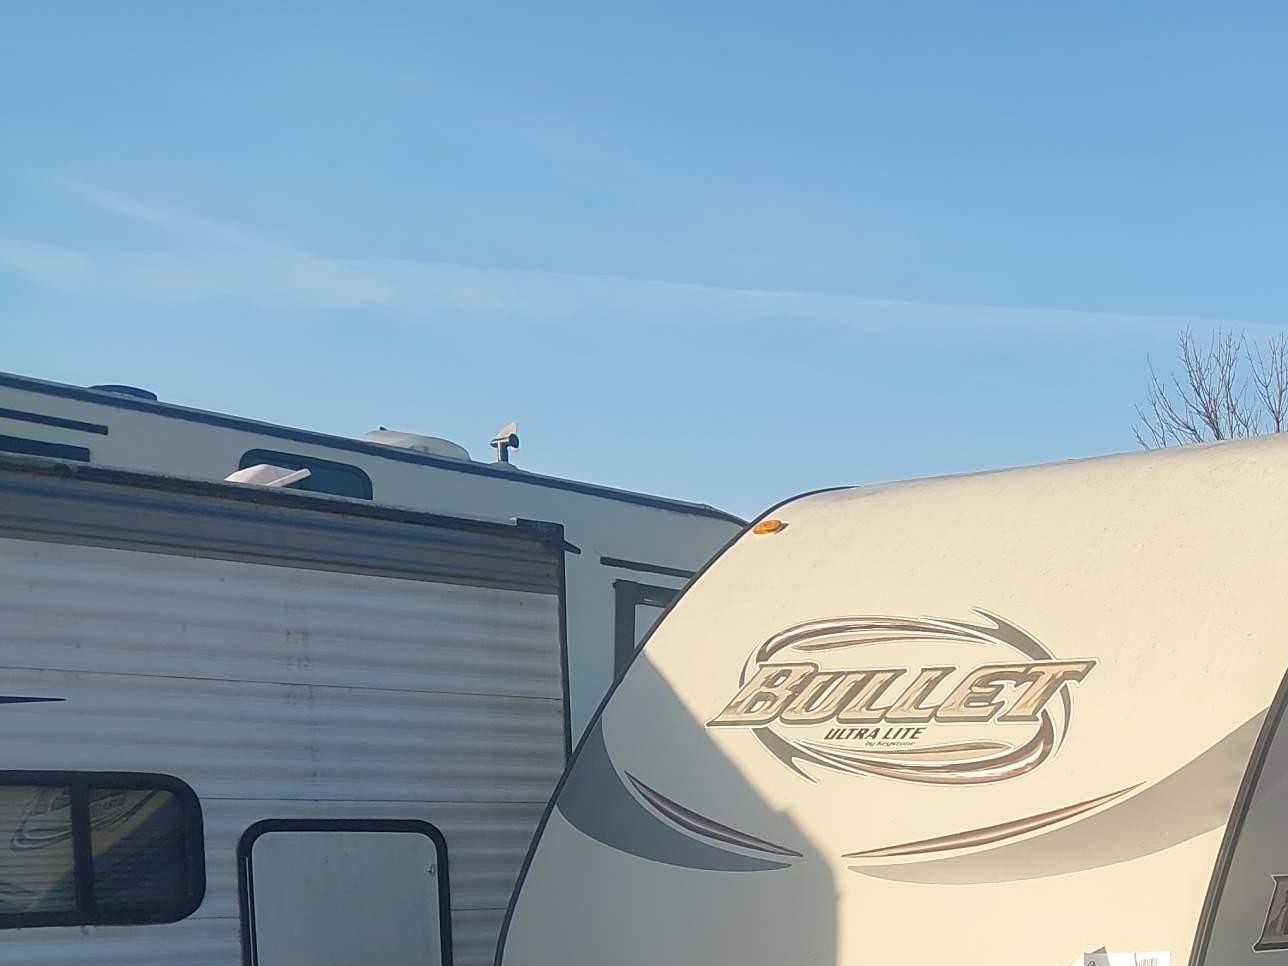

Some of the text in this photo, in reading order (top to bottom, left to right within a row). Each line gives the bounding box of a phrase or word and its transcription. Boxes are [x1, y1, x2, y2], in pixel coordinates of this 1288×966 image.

[705, 659, 1099, 728] BULLET
[824, 728, 927, 740] ULTRA LITE
